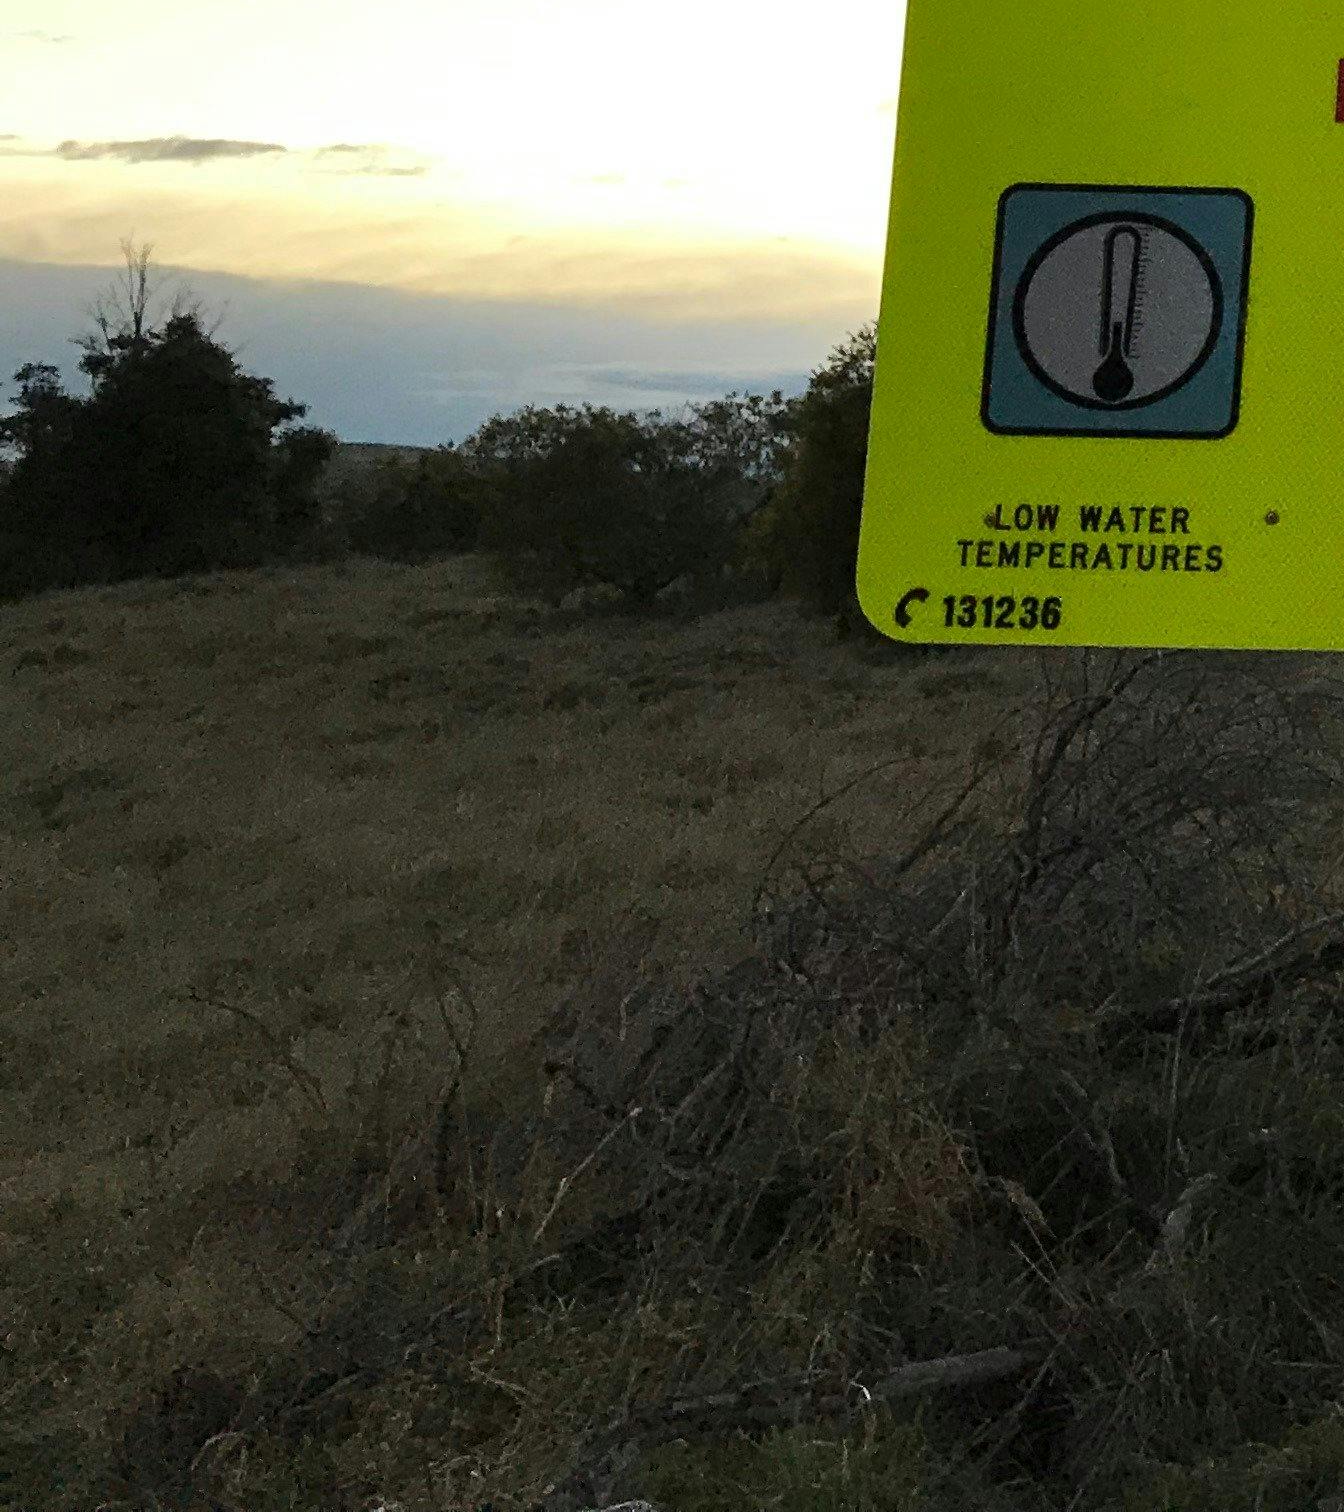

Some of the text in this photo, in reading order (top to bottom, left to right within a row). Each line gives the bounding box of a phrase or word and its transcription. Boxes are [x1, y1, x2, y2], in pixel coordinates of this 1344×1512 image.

[995, 504, 1191, 533] LOW WATER
[955, 540, 1224, 570] TEMPERATURES
[942, 595, 1062, 628] 131236
